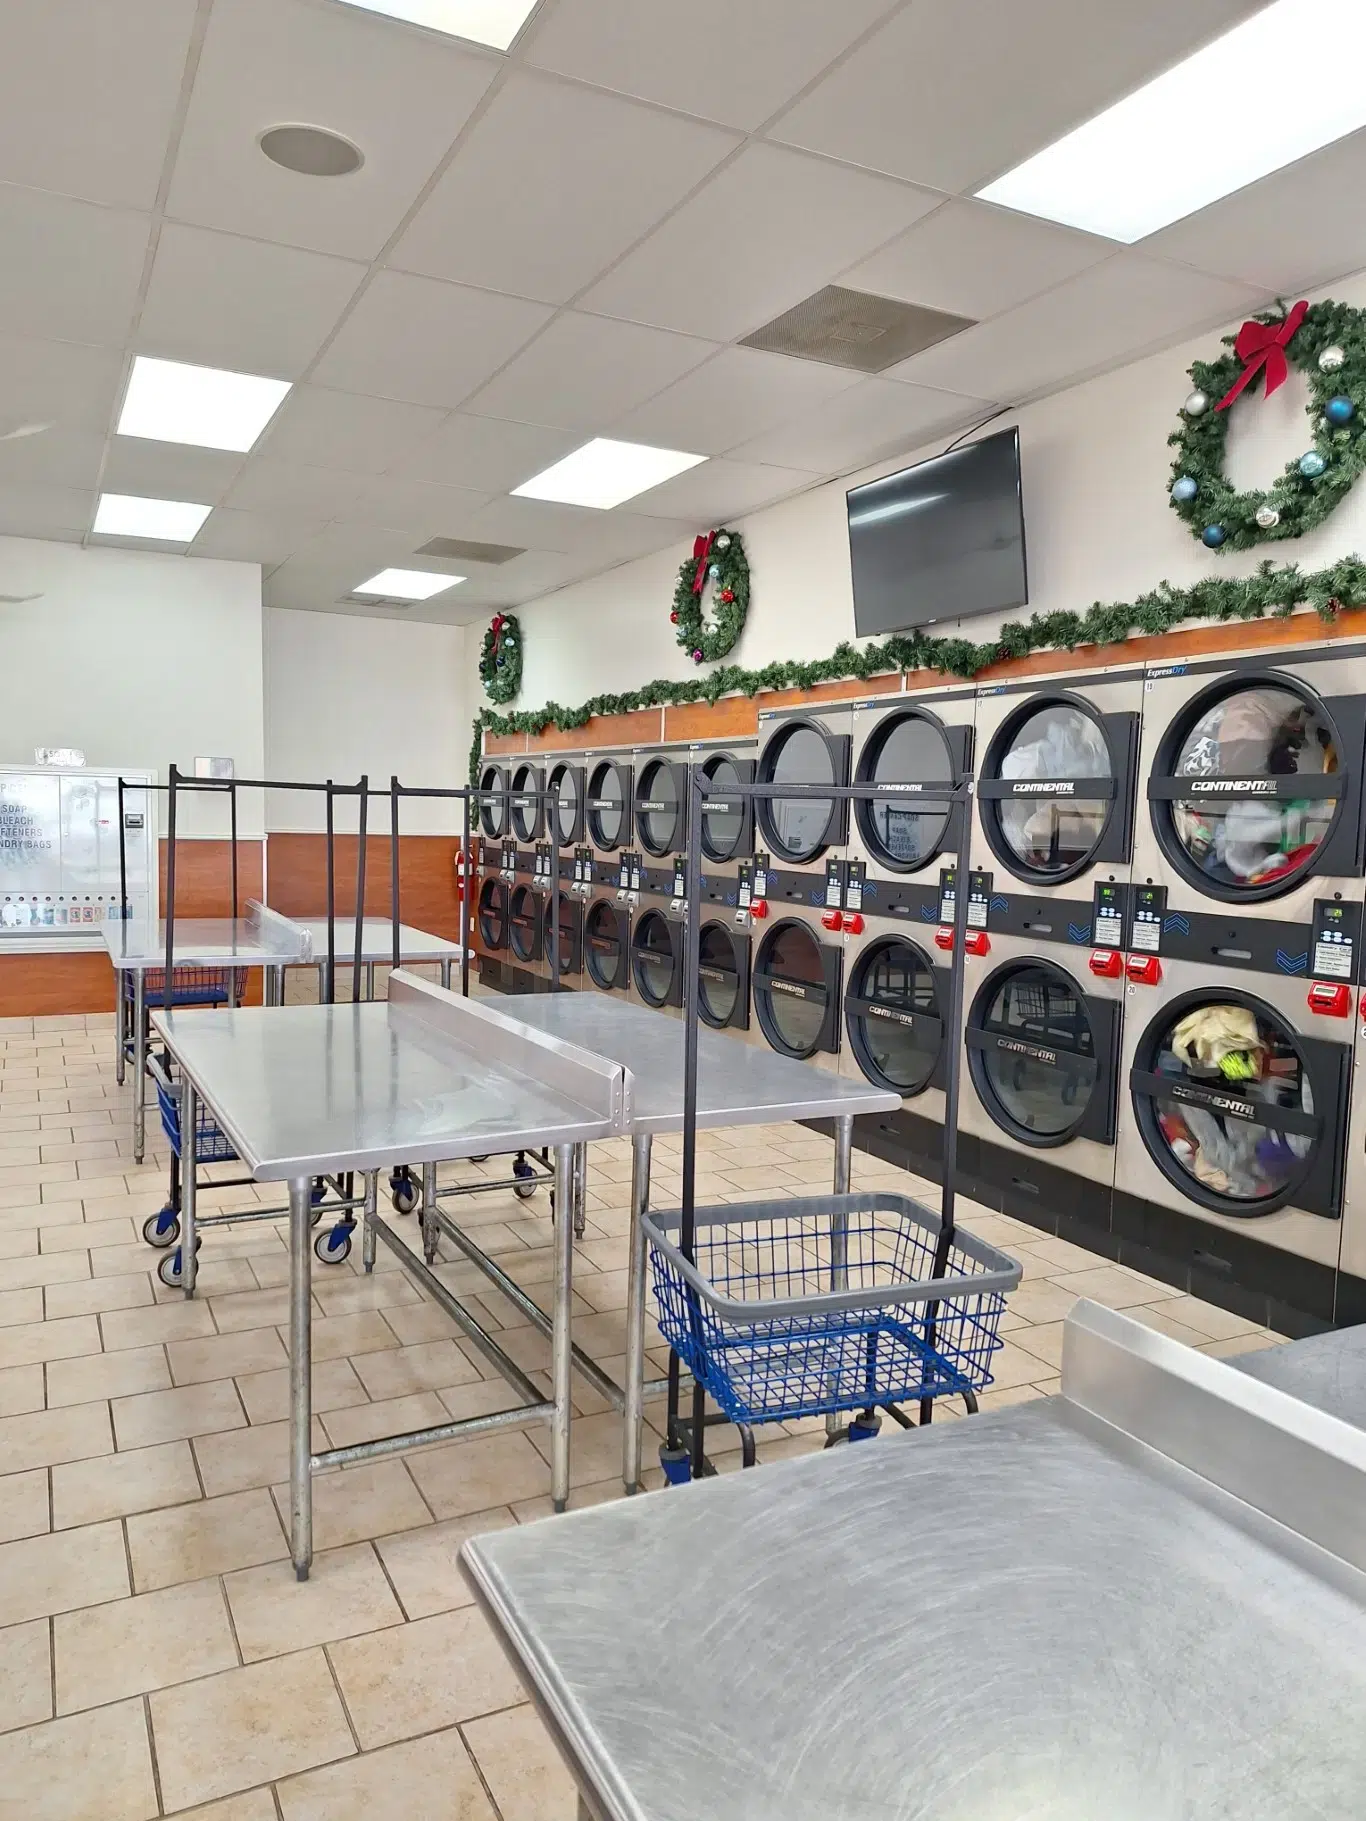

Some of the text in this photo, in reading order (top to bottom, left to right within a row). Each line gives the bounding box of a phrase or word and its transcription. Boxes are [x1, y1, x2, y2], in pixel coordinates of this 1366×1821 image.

[1147, 665, 1187, 678] ExpressDry
[1013, 782, 1074, 792] CONTINENTAL
[1191, 780, 1277, 791] CONTINENTAL
[27, 840, 52, 849] BAGS
[1129, 986, 1135, 994] 20
[869, 1005, 912, 1024] CONTINENTAL
[998, 1039, 1056, 1061] CONTINENTAL
[1172, 1085, 1255, 1115] CONTINENTAL
